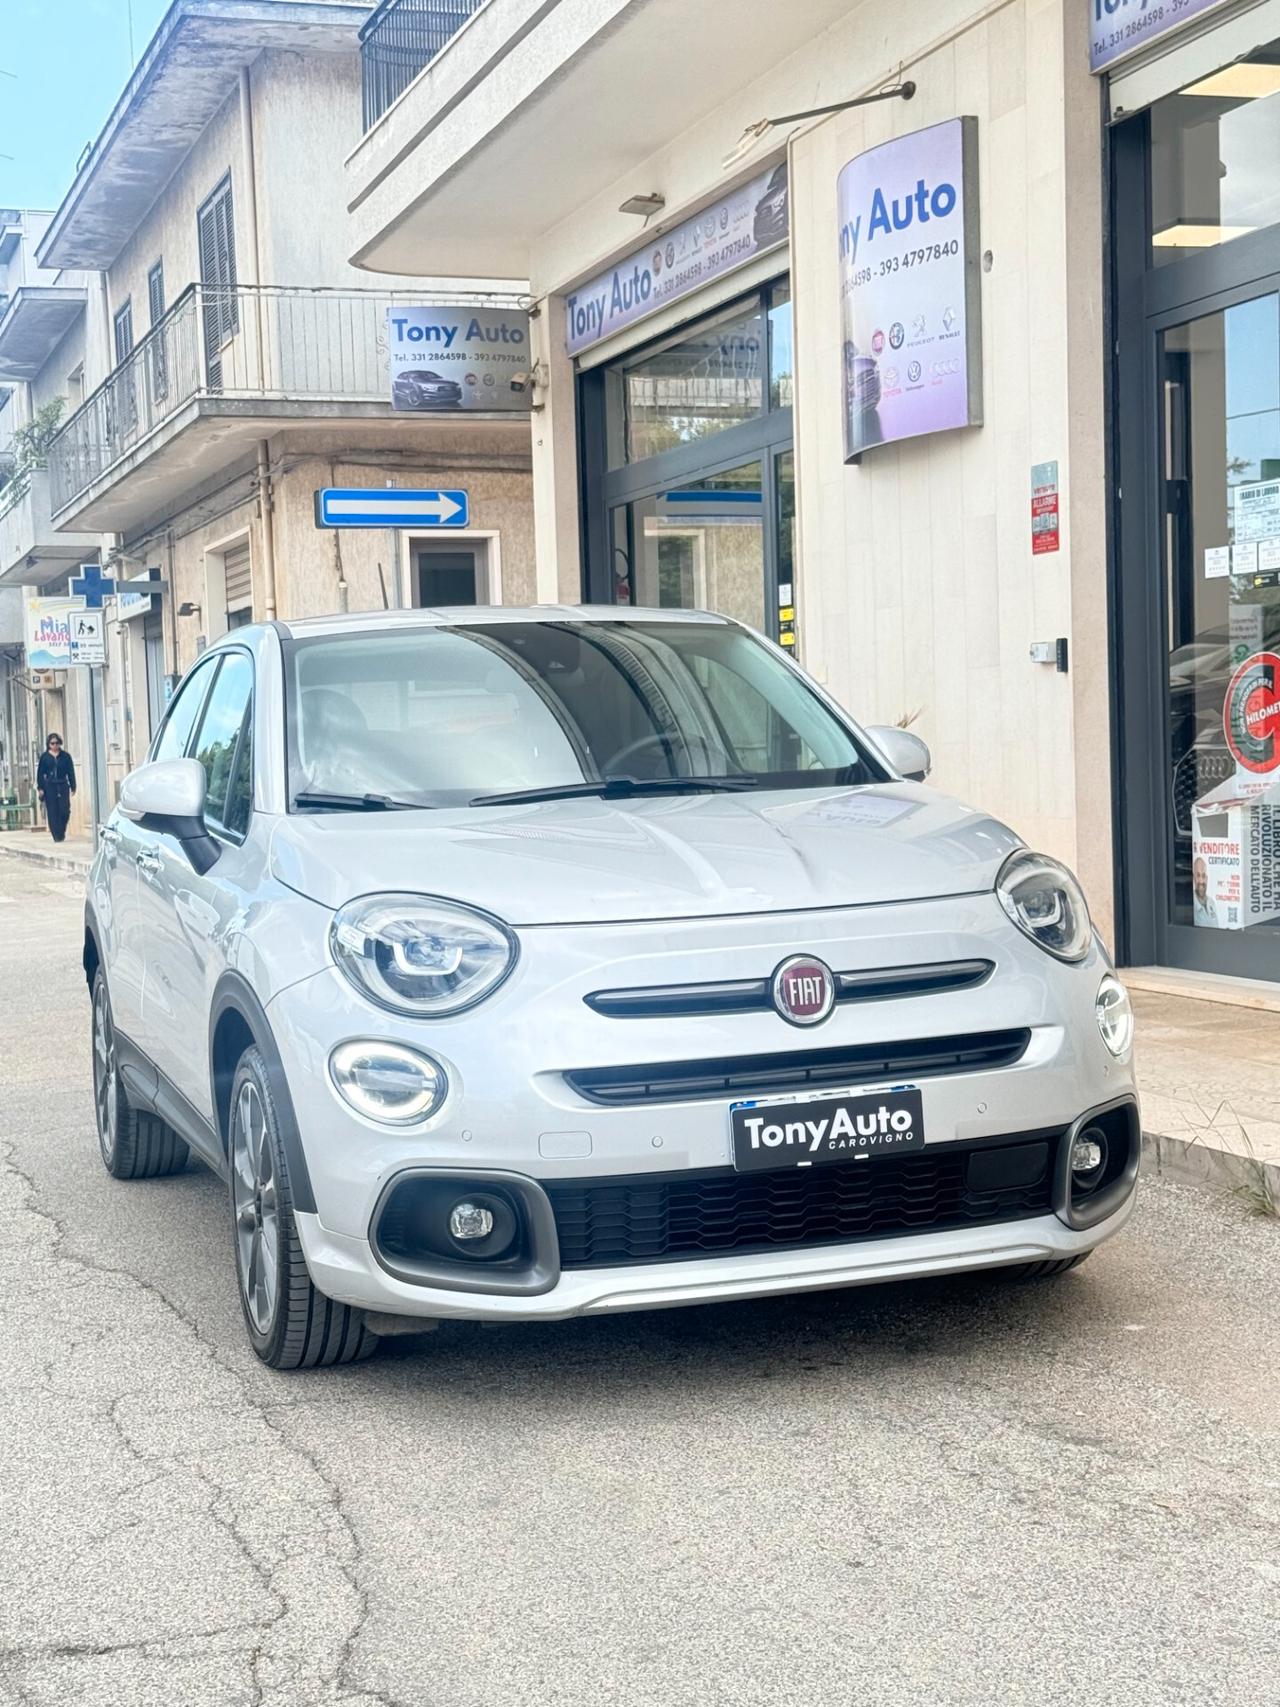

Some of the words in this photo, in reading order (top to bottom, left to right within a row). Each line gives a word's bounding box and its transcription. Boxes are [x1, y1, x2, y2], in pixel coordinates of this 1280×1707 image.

[1094, 39, 1108, 55] Tel.
[1109, 30, 1123, 47] 331
[1125, 7, 1164, 38] 2864598
[839, 215, 861, 265] ny
[868, 179, 956, 241] Auto
[880, 257, 899, 276] 393
[902, 239, 959, 268] 4797840
[567, 293, 606, 340] Tony
[609, 266, 651, 319] Auto
[391, 318, 458, 348] Tony
[465, 318, 525, 344] Auto
[394, 353, 408, 362] Tel.
[412, 353, 426, 361] 331
[428, 352, 467, 361] 2864598
[474, 353, 490, 361] 393
[492, 354, 527, 363] 4797840
[40, 616, 68, 632] Mia
[1250, 805, 1260, 856] MERCATO
[1208, 856, 1240, 867] CERTIFICATO
[1261, 804, 1272, 898] RIVOLUZIONATO
[1250, 860, 1260, 913] DELL'AUTO
[1261, 901, 1272, 912] IL
[789, 976, 822, 1006] FIAT
[744, 1106, 913, 1151] TonyAuto
[829, 1132, 914, 1150] CAROVIGNO
